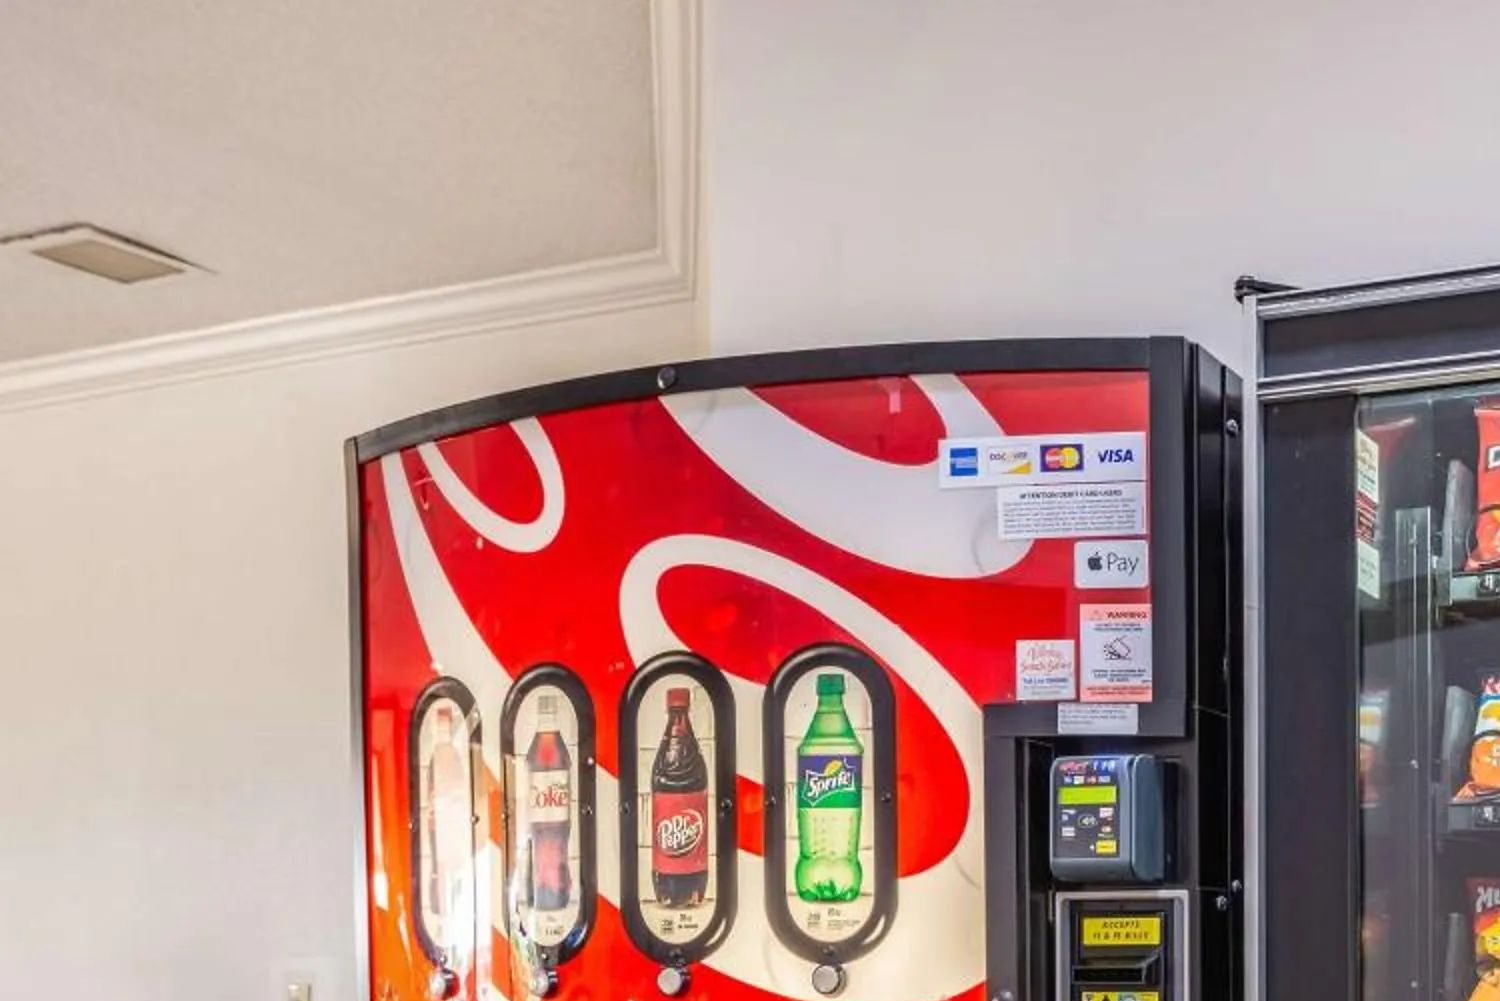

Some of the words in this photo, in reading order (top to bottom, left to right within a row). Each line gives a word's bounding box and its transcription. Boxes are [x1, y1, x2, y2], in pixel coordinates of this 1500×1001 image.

[1097, 448, 1134, 463] VISA
[1106, 553, 1140, 575] Pay
[807, 771, 853, 797] Sprite
[672, 814, 688, 831] Dr
[660, 819, 702, 850] Pepper
